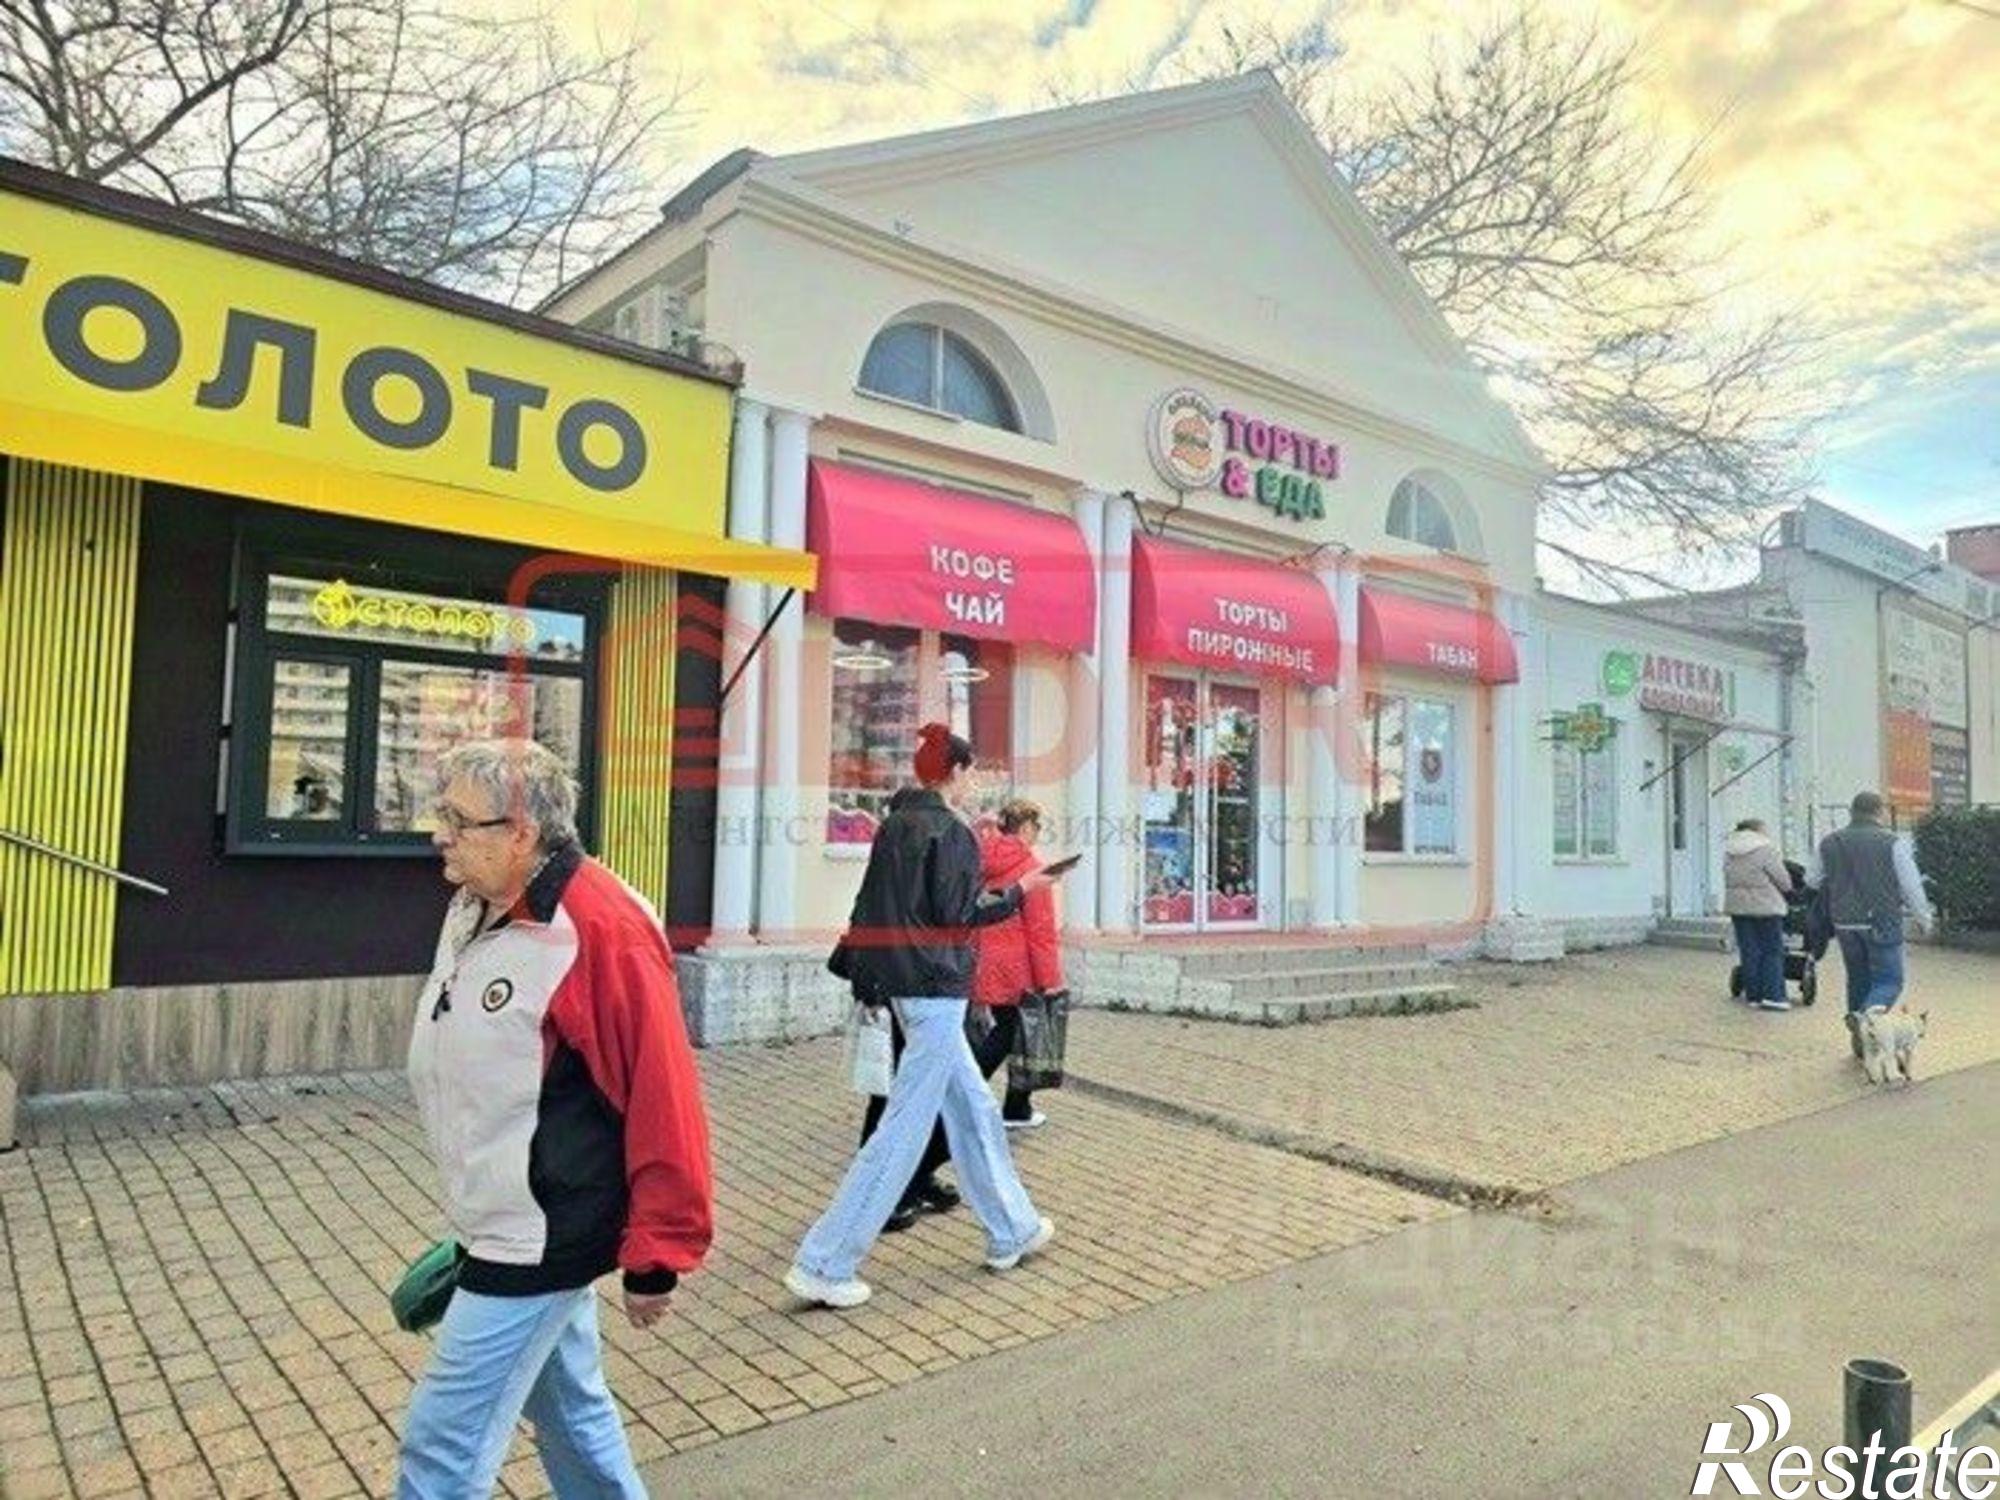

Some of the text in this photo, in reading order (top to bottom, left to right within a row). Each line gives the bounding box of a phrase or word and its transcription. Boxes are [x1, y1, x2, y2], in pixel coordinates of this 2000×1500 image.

[0, 251, 647, 493] ОЛОТО
[1220, 408, 1339, 482] ТОРТЫ
[1220, 456, 1327, 523] & ЕДА
[930, 544, 1015, 586] КОФЕ
[945, 590, 1005, 626] ЧАЙ
[1214, 597, 1288, 633] ТОРТЫ
[1187, 627, 1314, 673] ПИРОЖНЫЕ
[1642, 652, 1724, 696] АПТЕКА
